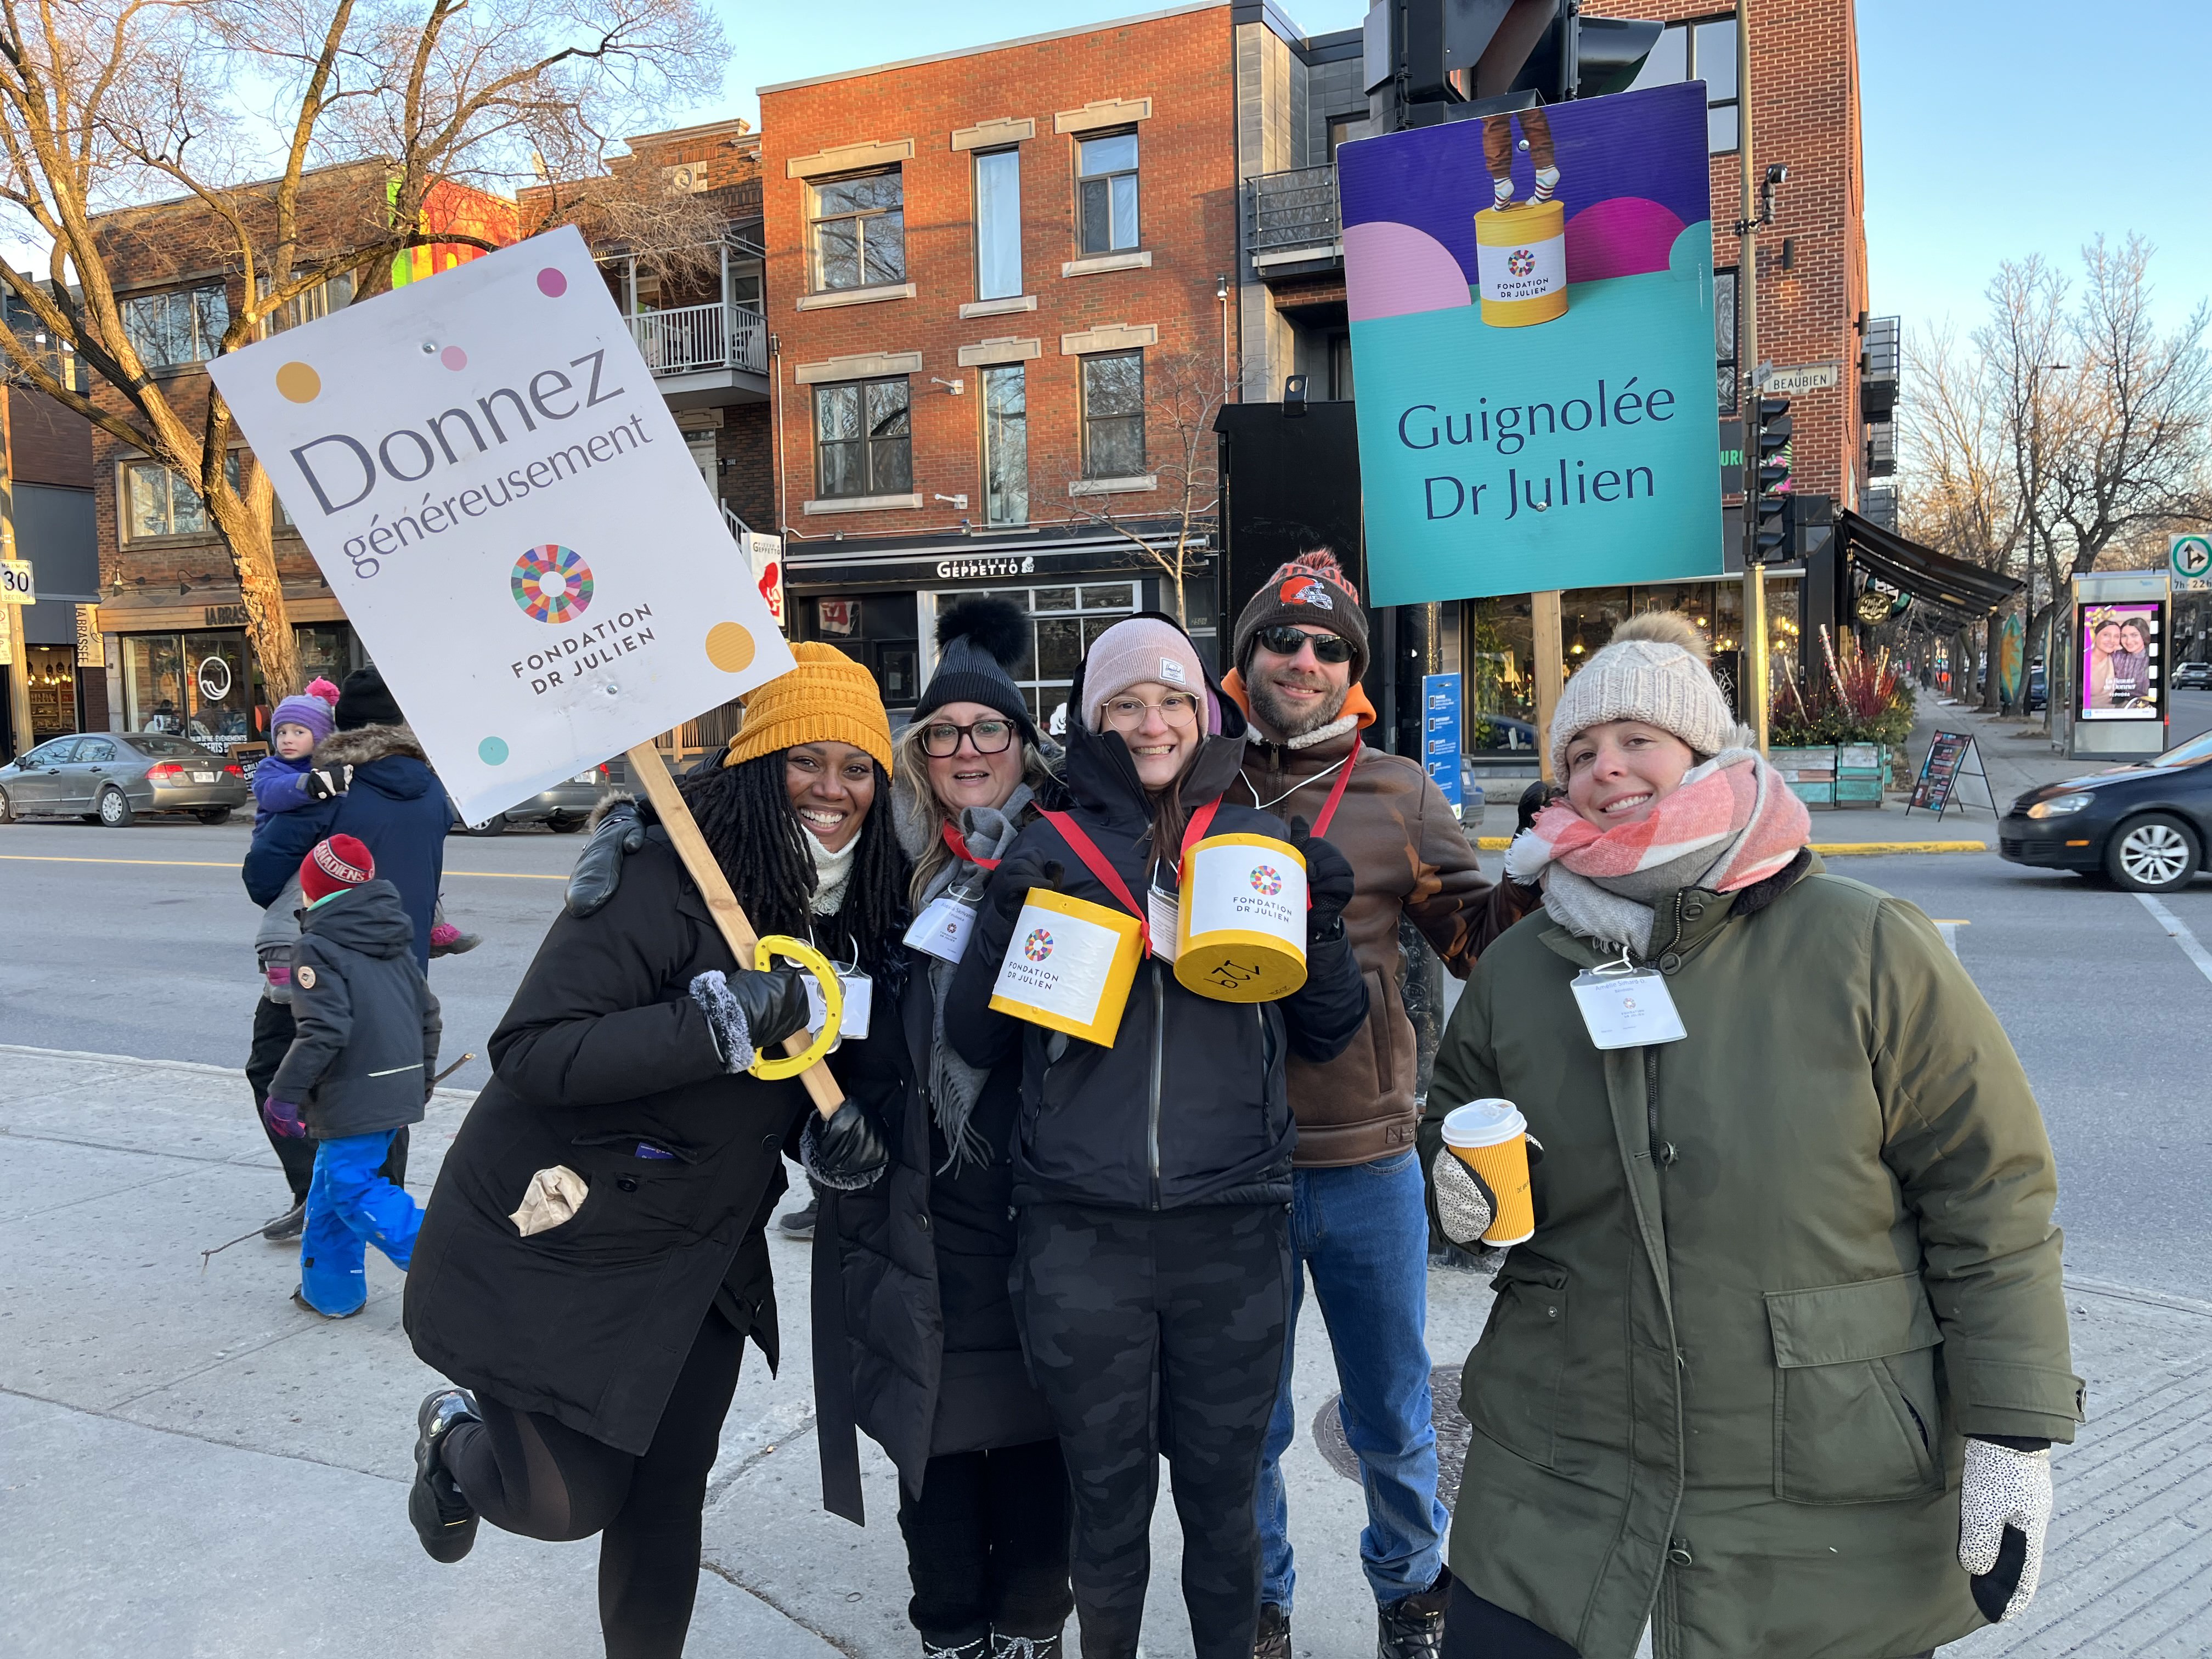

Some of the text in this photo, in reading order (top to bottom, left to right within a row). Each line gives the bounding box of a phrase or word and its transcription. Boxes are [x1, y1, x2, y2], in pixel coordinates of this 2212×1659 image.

[1498, 278, 1548, 289] FONDATION
[1515, 286, 1545, 297] JULIEN
[1774, 374, 1827, 390] BEAUBIEN
[1399, 377, 1675, 454] Guignolée
[290, 349, 625, 516] Donnez
[1721, 450, 1742, 466] UR
[343, 414, 653, 579] généreusement
[1425, 459, 1654, 520] Dr Julien
[753, 542, 781, 555] GEPPETTO
[937, 562, 1018, 578] GEPPETTO
[953, 558, 1015, 567] PIZZERIA
[4, 571, 29, 592] 30
[217, 606, 246, 624] BRAS
[76, 619, 91, 663] BRASSÉE
[511, 603, 653, 678] FONDATION
[531, 628, 654, 695] DR JULIEN
[1233, 897, 1291, 915] FONDATION
[1255, 908, 1289, 922] JULIEN
[1009, 962, 1058, 981] FONDATION
[1018, 975, 1052, 990] JULIEN
